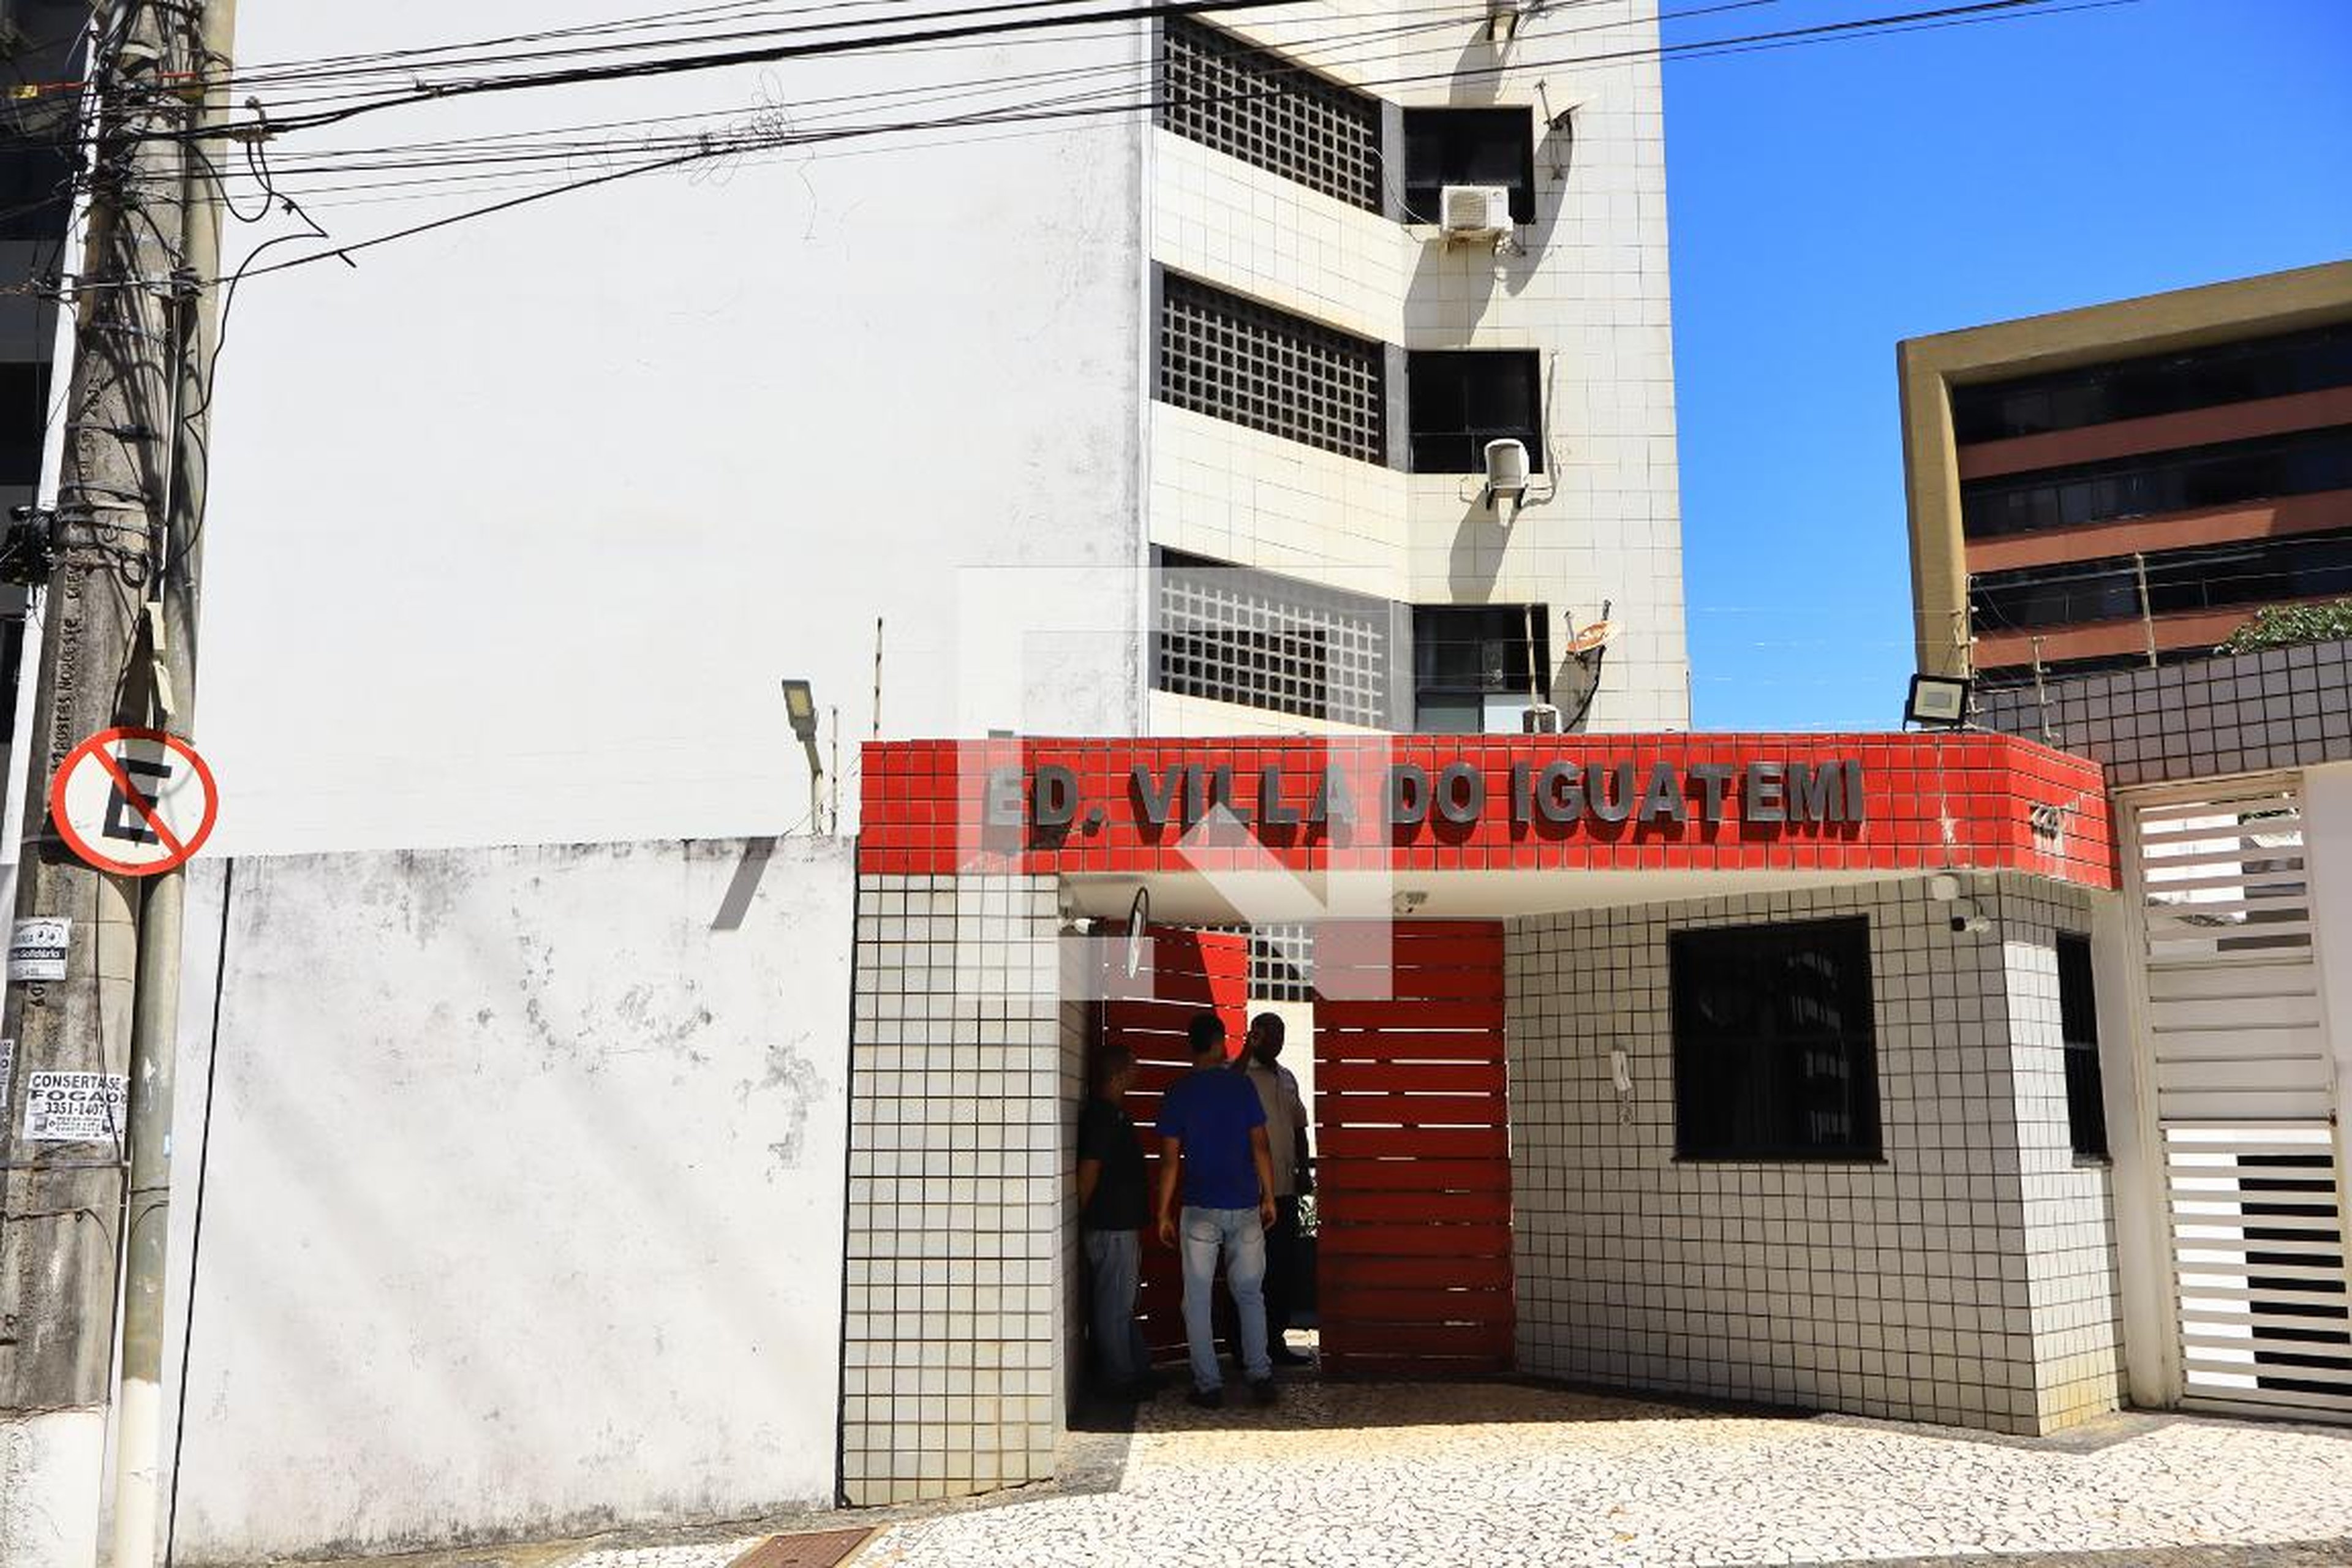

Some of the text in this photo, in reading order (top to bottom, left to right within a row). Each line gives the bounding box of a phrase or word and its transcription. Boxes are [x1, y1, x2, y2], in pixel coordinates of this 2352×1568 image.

[102, 757, 172, 845] E
[989, 758, 1863, 826] ED. VILLA DO IGUATEMI
